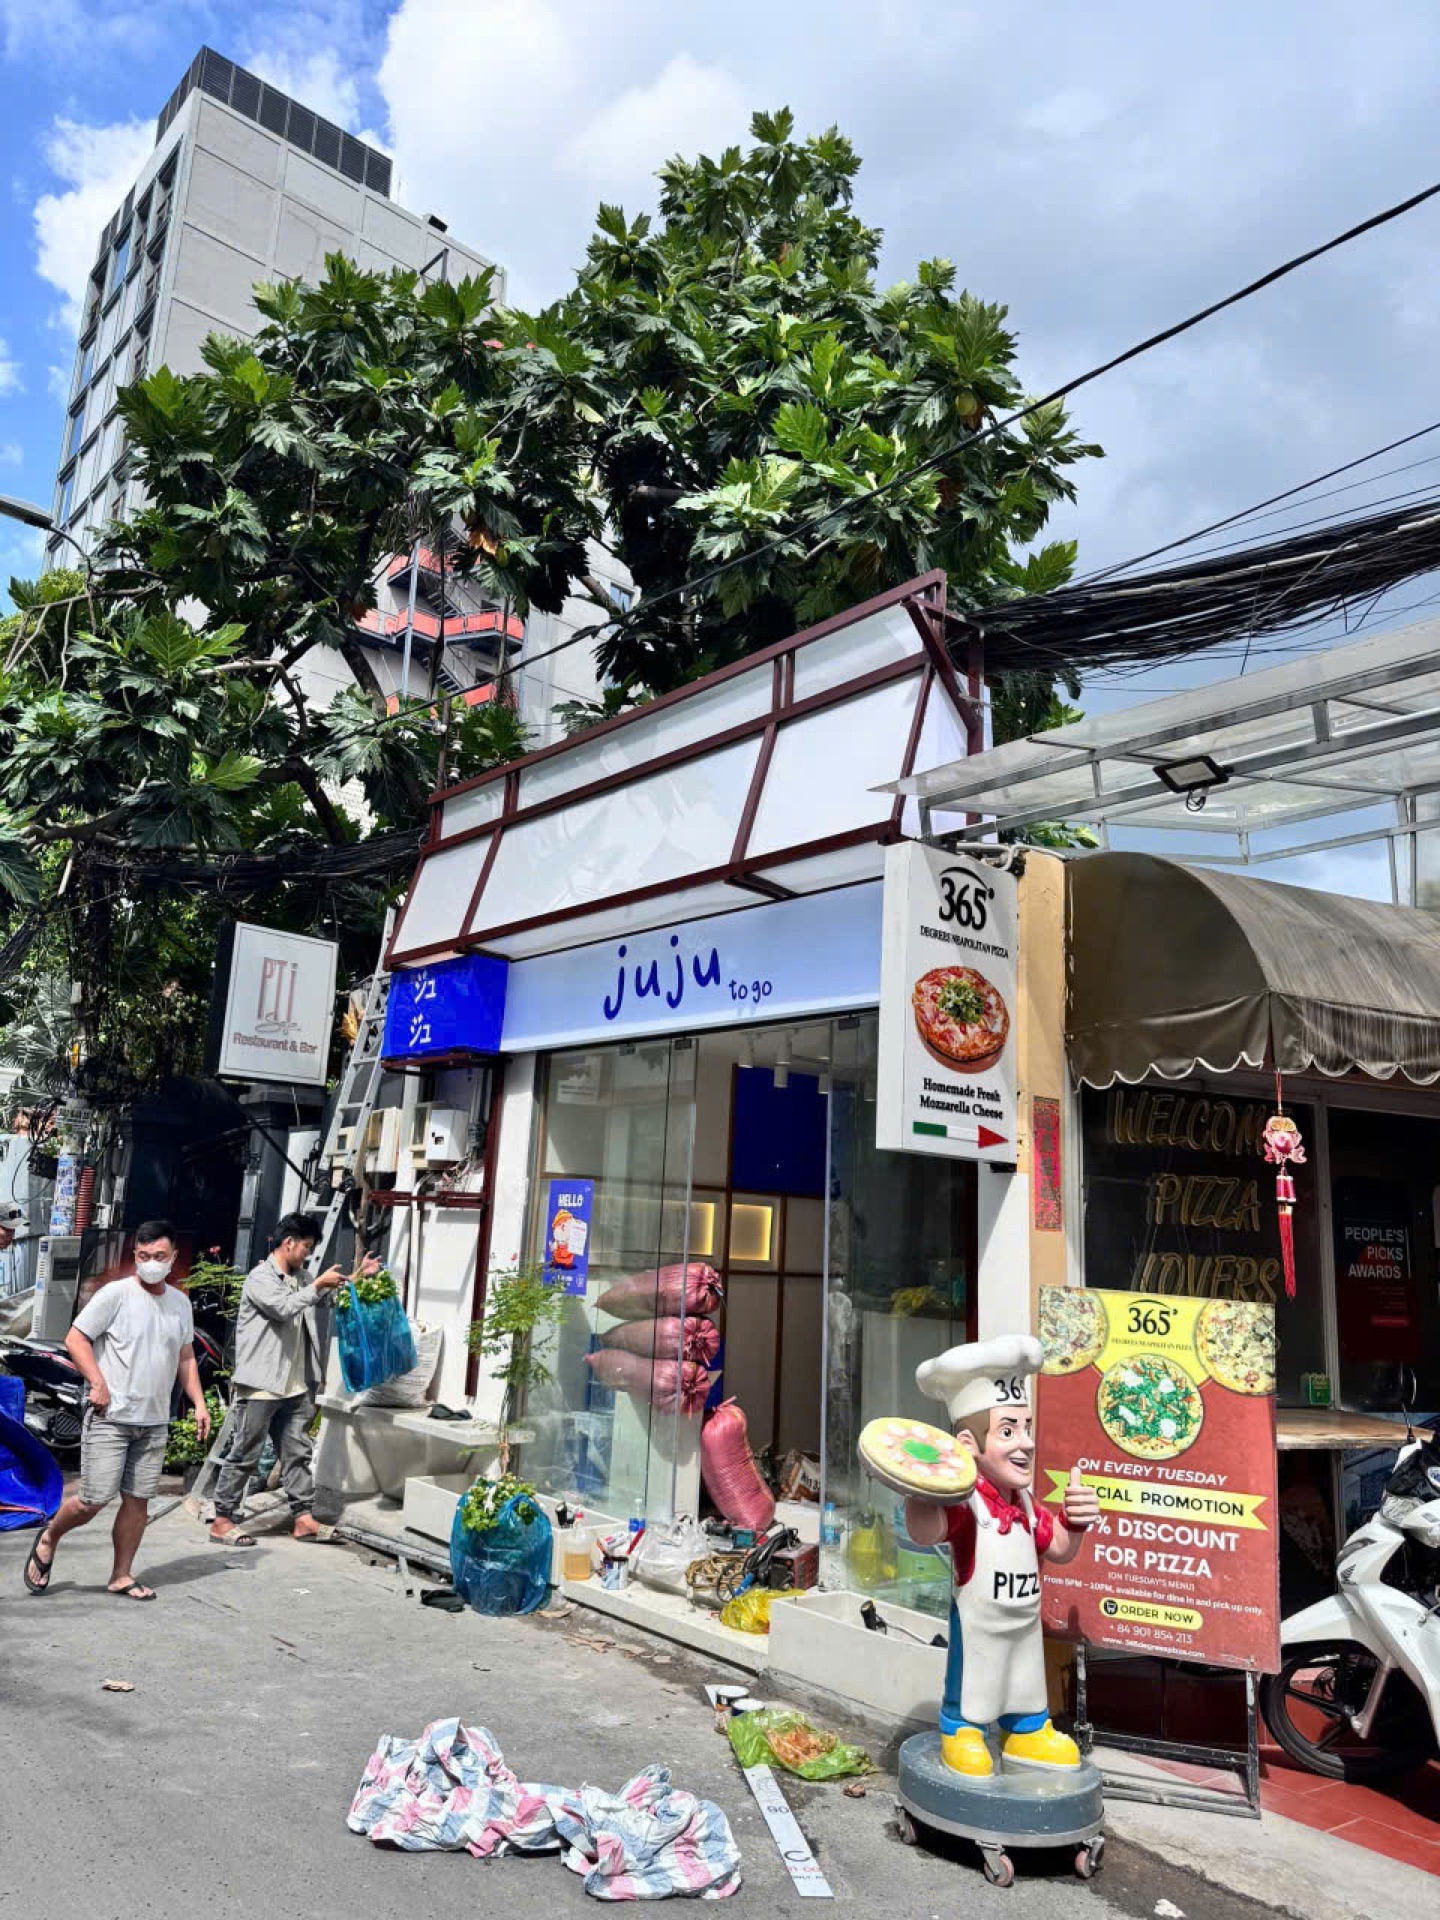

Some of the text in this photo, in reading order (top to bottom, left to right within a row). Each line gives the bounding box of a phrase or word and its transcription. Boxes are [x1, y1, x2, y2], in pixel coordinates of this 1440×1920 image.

[991, 945, 1009, 959] PIZZA
[414, 969, 437, 1004] ジュ
[603, 935, 721, 1020] juju
[233, 1032, 318, 1055] Restaurant & Bar
[409, 1013, 432, 1048] ジュ
[923, 1077, 1001, 1103] Homemade Fresh
[919, 1094, 1004, 1120] Mozzarella Cheese
[1114, 1089, 1291, 1155] WELCOM
[557, 1193, 584, 1207] HELLO
[1154, 1173, 1262, 1232] PIZZA
[1344, 1226, 1405, 1242] PEOPLE'S
[1367, 1245, 1404, 1261] PICKS
[1348, 1263, 1402, 1279] AWARDS
[1077, 1457, 1228, 1486] ON EVERY TUESDAY
[1140, 1491, 1245, 1517] PROMOTION
[1118, 1517, 1240, 1552] DISCOUNT
[1094, 1544, 1213, 1579] FOR PIZZA
[1043, 1574, 1064, 1586] From
[1115, 1586, 1152, 1599] available
[1152, 1590, 1165, 1600] for
[1166, 1593, 1186, 1604] dine
[1195, 1599, 1211, 1607] and
[1212, 1600, 1230, 1610] pick
[1230, 1604, 1243, 1613] up
[1120, 1604, 1194, 1625] ORDER NOW
[1116, 1623, 1131, 1635] 84
[1132, 1625, 1151, 1638] 901
[1153, 1629, 1174, 1641] 854
[1175, 1632, 1193, 1645] 213
